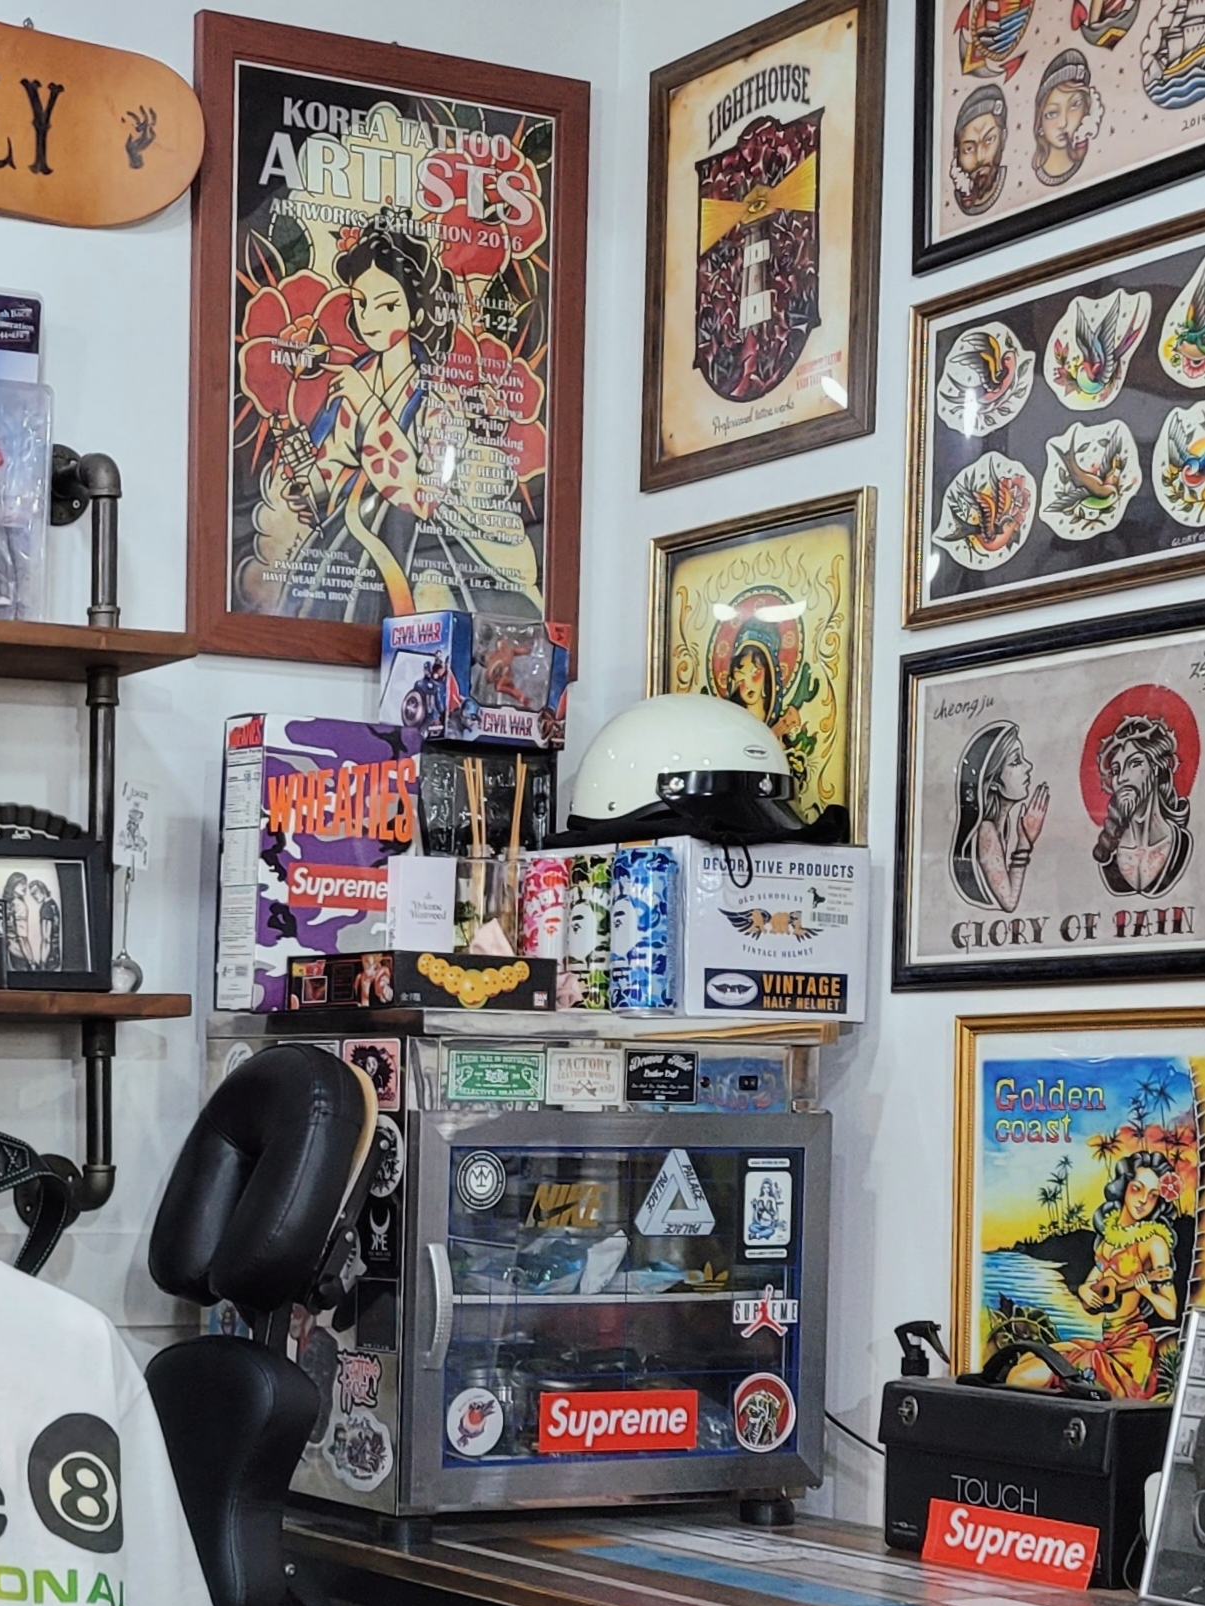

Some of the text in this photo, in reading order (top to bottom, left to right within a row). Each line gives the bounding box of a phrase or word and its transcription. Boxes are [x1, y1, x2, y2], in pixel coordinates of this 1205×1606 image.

[707, 64, 811, 150] LIGHTHOUSE
[283, 97, 512, 161] KOREA TATTOO
[259, 132, 534, 226] ARTISTS
[269, 199, 522, 251] ARTWORKS EXHIBITION 2016
[435, 306, 517, 332] MAY 21-22
[473, 295, 519, 311] GALLERY
[271, 350, 315, 368] HAVIT
[436, 351, 471, 364] TATTOO
[391, 621, 442, 648] CIVIL WAR
[483, 712, 533, 737] CIVIL WAR
[268, 758, 417, 843] WHEATIES
[703, 857, 854, 878] DECORTIVE PRODUCTS
[292, 867, 388, 904] Supreme
[758, 893, 791, 901] SCHOOL
[951, 906, 1196, 954] GLORY OF PAIN
[742, 944, 814, 958] VINTAGE HELMET
[762, 973, 841, 996] VINTAGE
[763, 996, 841, 1011] HALF HELMET
[558, 1057, 612, 1071] FACTORY
[995, 1077, 1106, 1112] Golden
[995, 1112, 1074, 1145] coast
[647, 1170, 668, 1213] PALACE
[682, 1164, 705, 1202] PALACE
[526, 1182, 608, 1228] NIKE
[664, 1223, 702, 1235] PALACE
[735, 1303, 797, 1320] SUPEME
[547, 1398, 688, 1447] Supreme
[951, 1474, 1038, 1515] TOUCH
[944, 1508, 1086, 1570] Supreme
